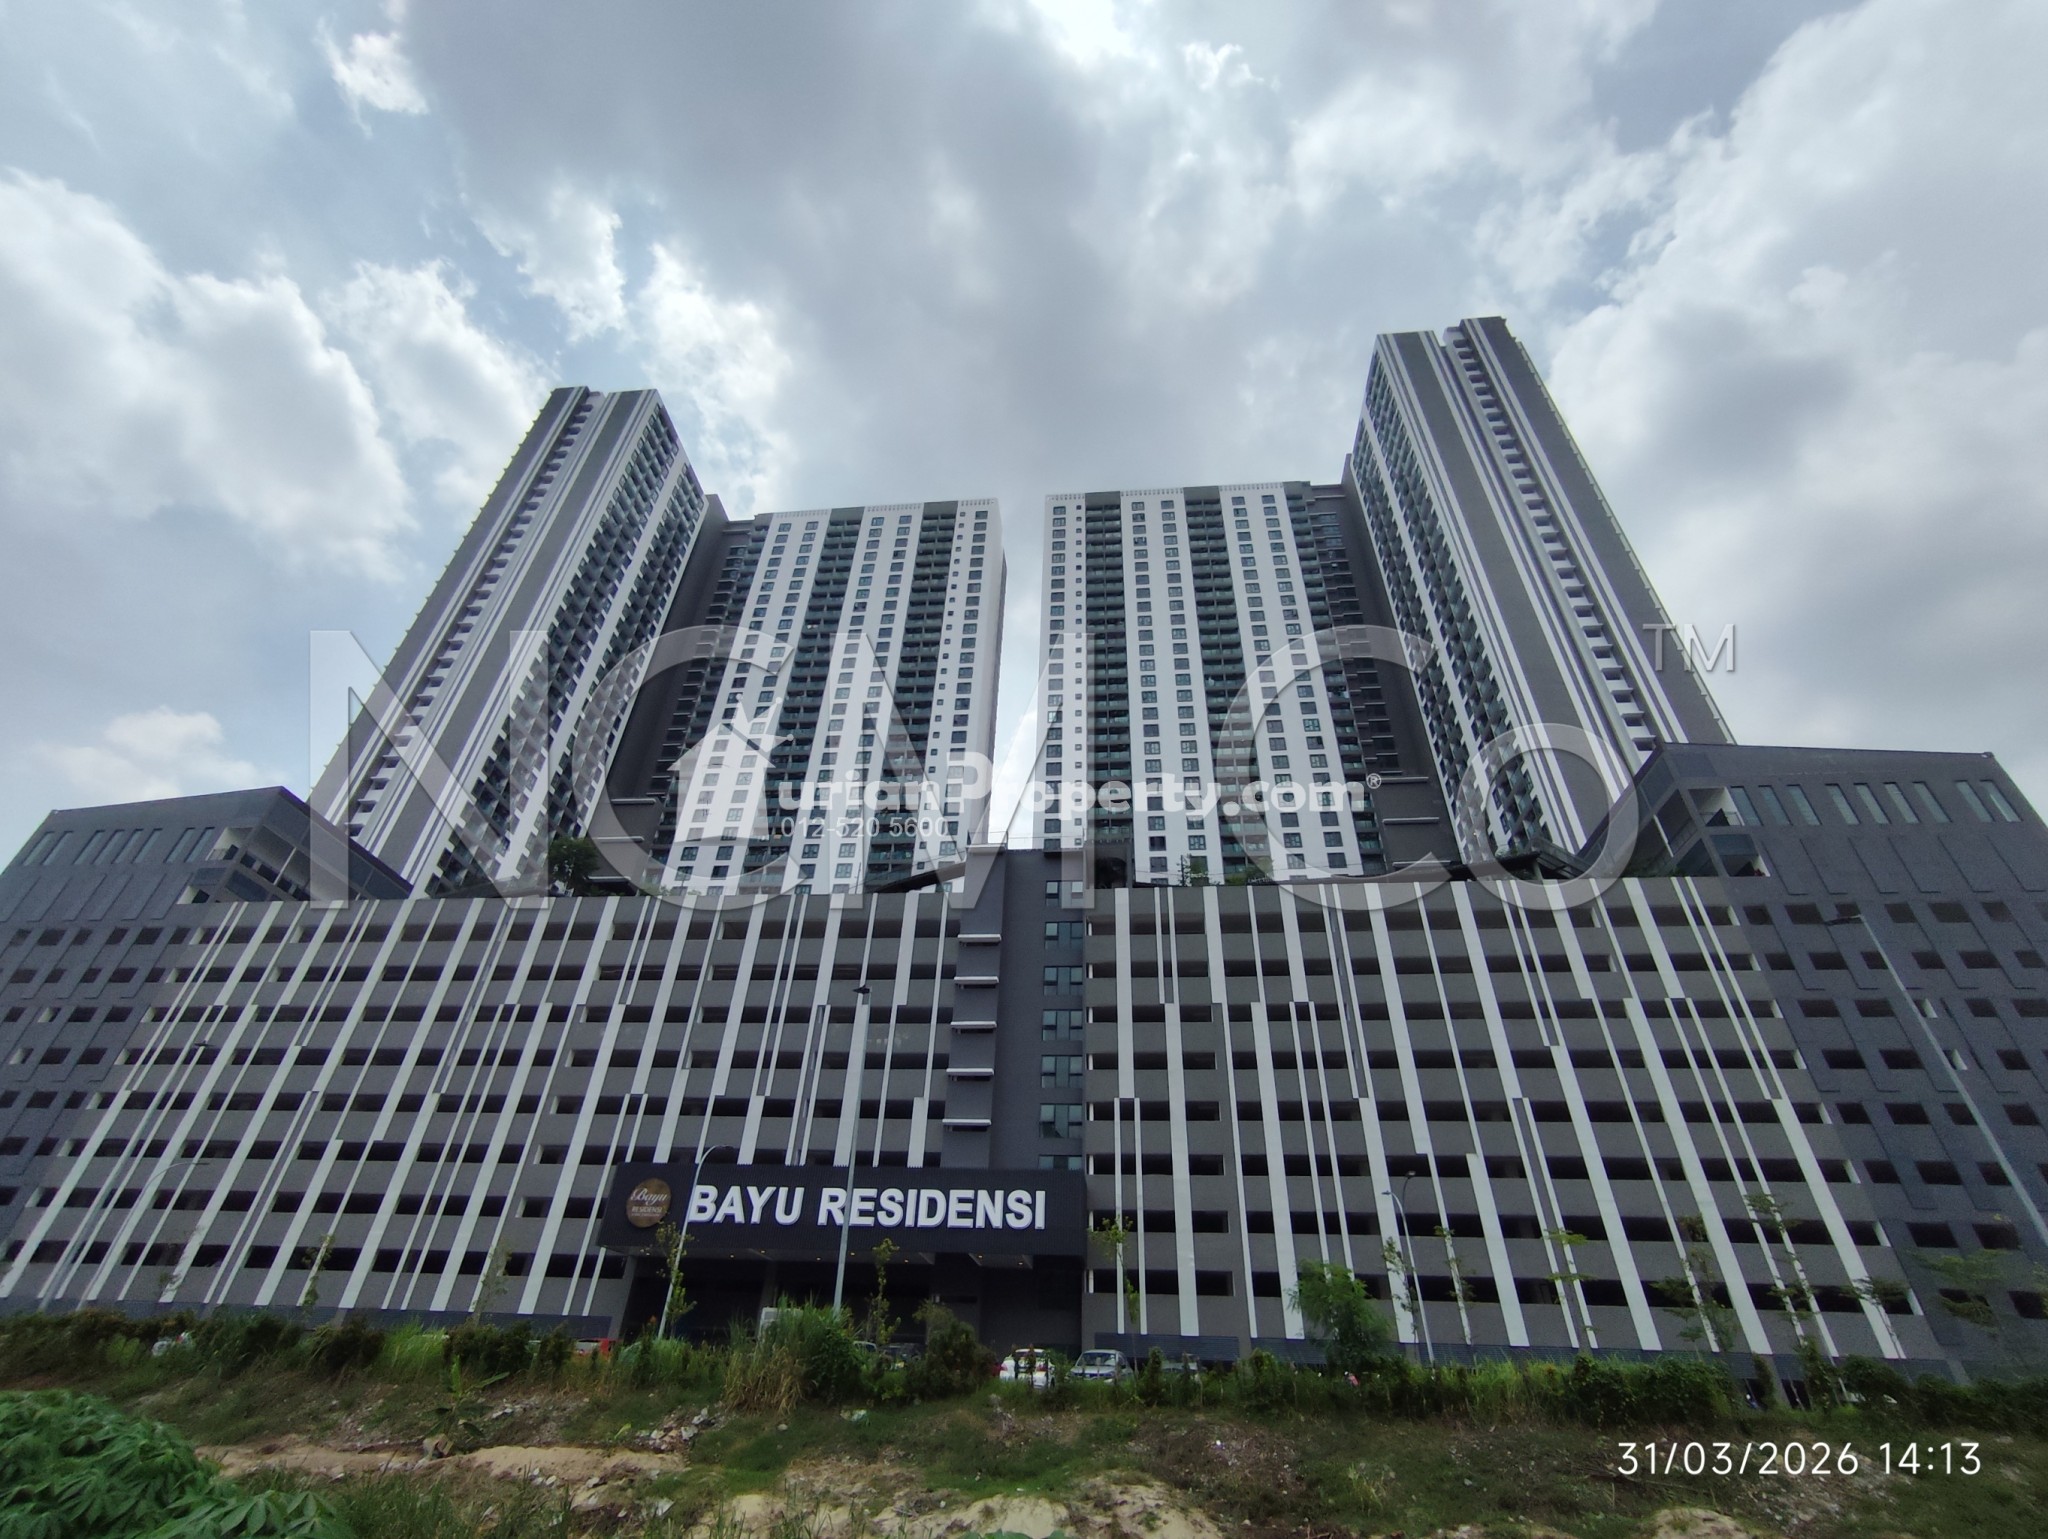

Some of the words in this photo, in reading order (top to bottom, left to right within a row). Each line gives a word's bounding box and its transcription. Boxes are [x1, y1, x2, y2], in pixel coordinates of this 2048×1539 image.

[630, 1187, 668, 1206] Bayu
[687, 1184, 805, 1226] BAYU
[817, 1186, 1047, 1231] RESIDENSI
